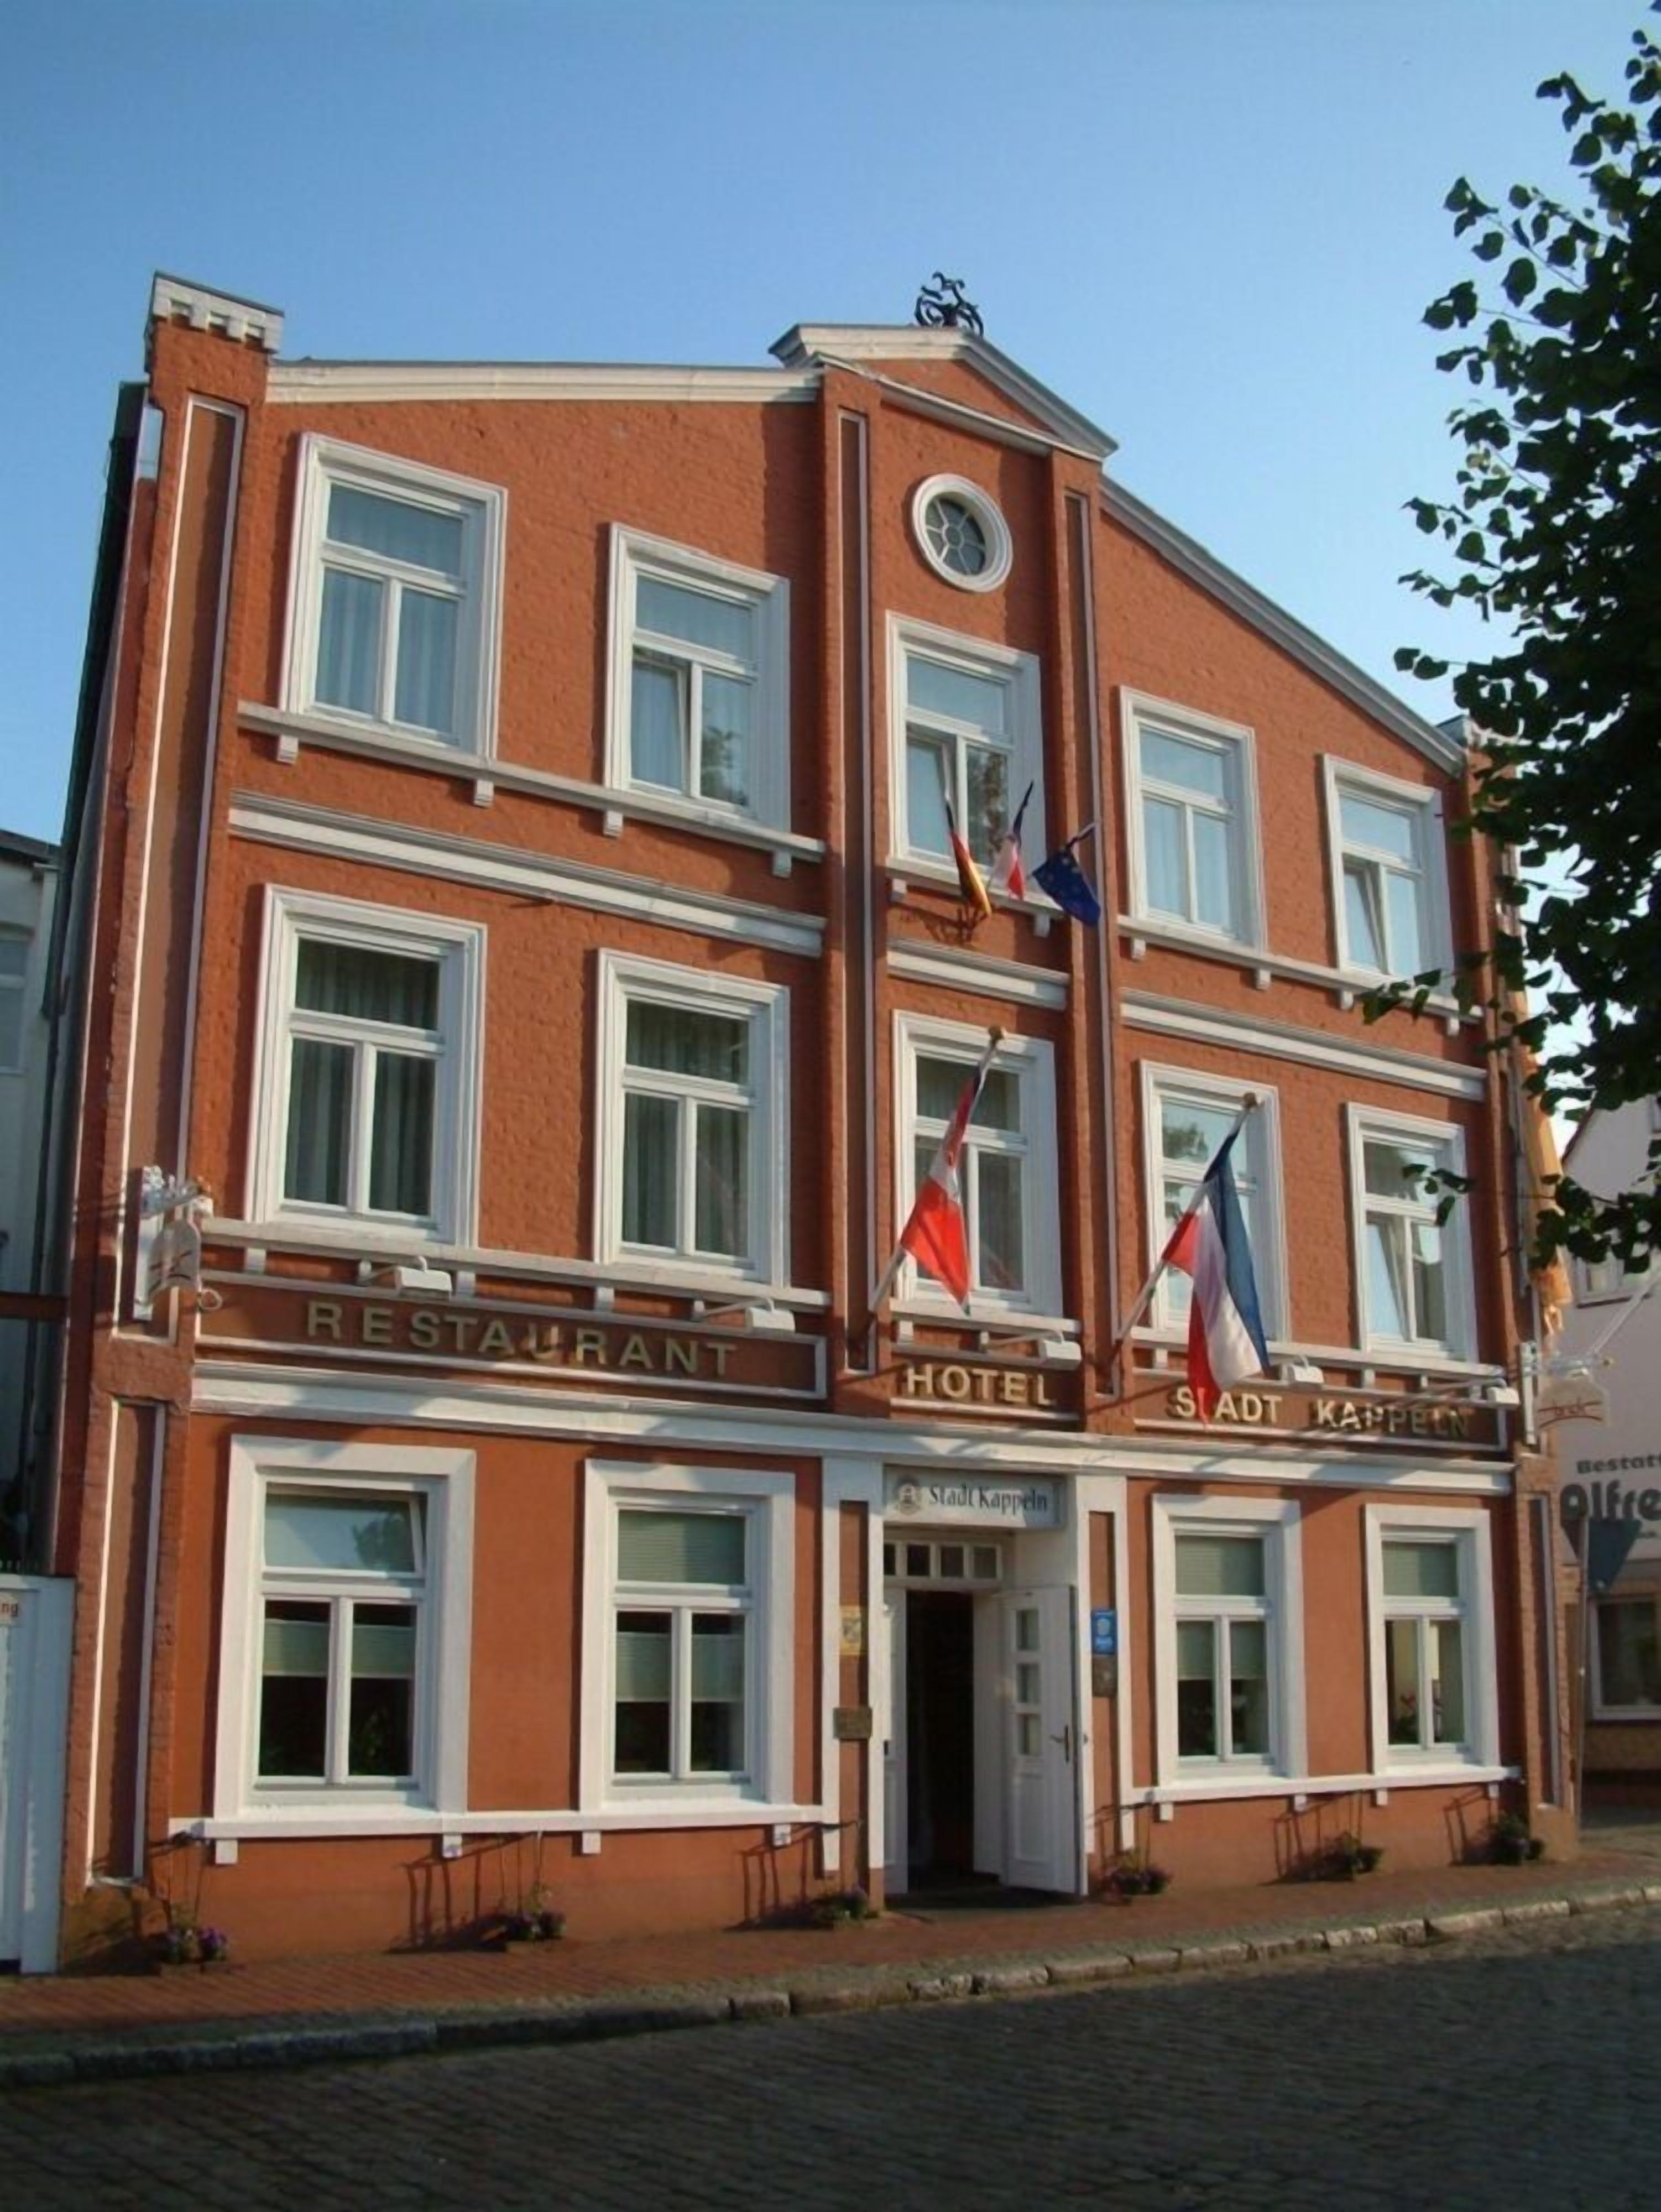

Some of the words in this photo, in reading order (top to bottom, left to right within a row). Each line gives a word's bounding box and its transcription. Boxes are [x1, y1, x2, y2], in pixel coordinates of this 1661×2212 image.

[307, 1301, 737, 1376] RESTAURANT
[907, 1363, 1056, 1406] HOTEL
[1317, 1398, 1469, 1438] KAPPELN
[1577, 1453, 1661, 1474] Bestat
[929, 1483, 973, 1506] Stadt
[979, 1486, 1047, 1515] Kappeln
